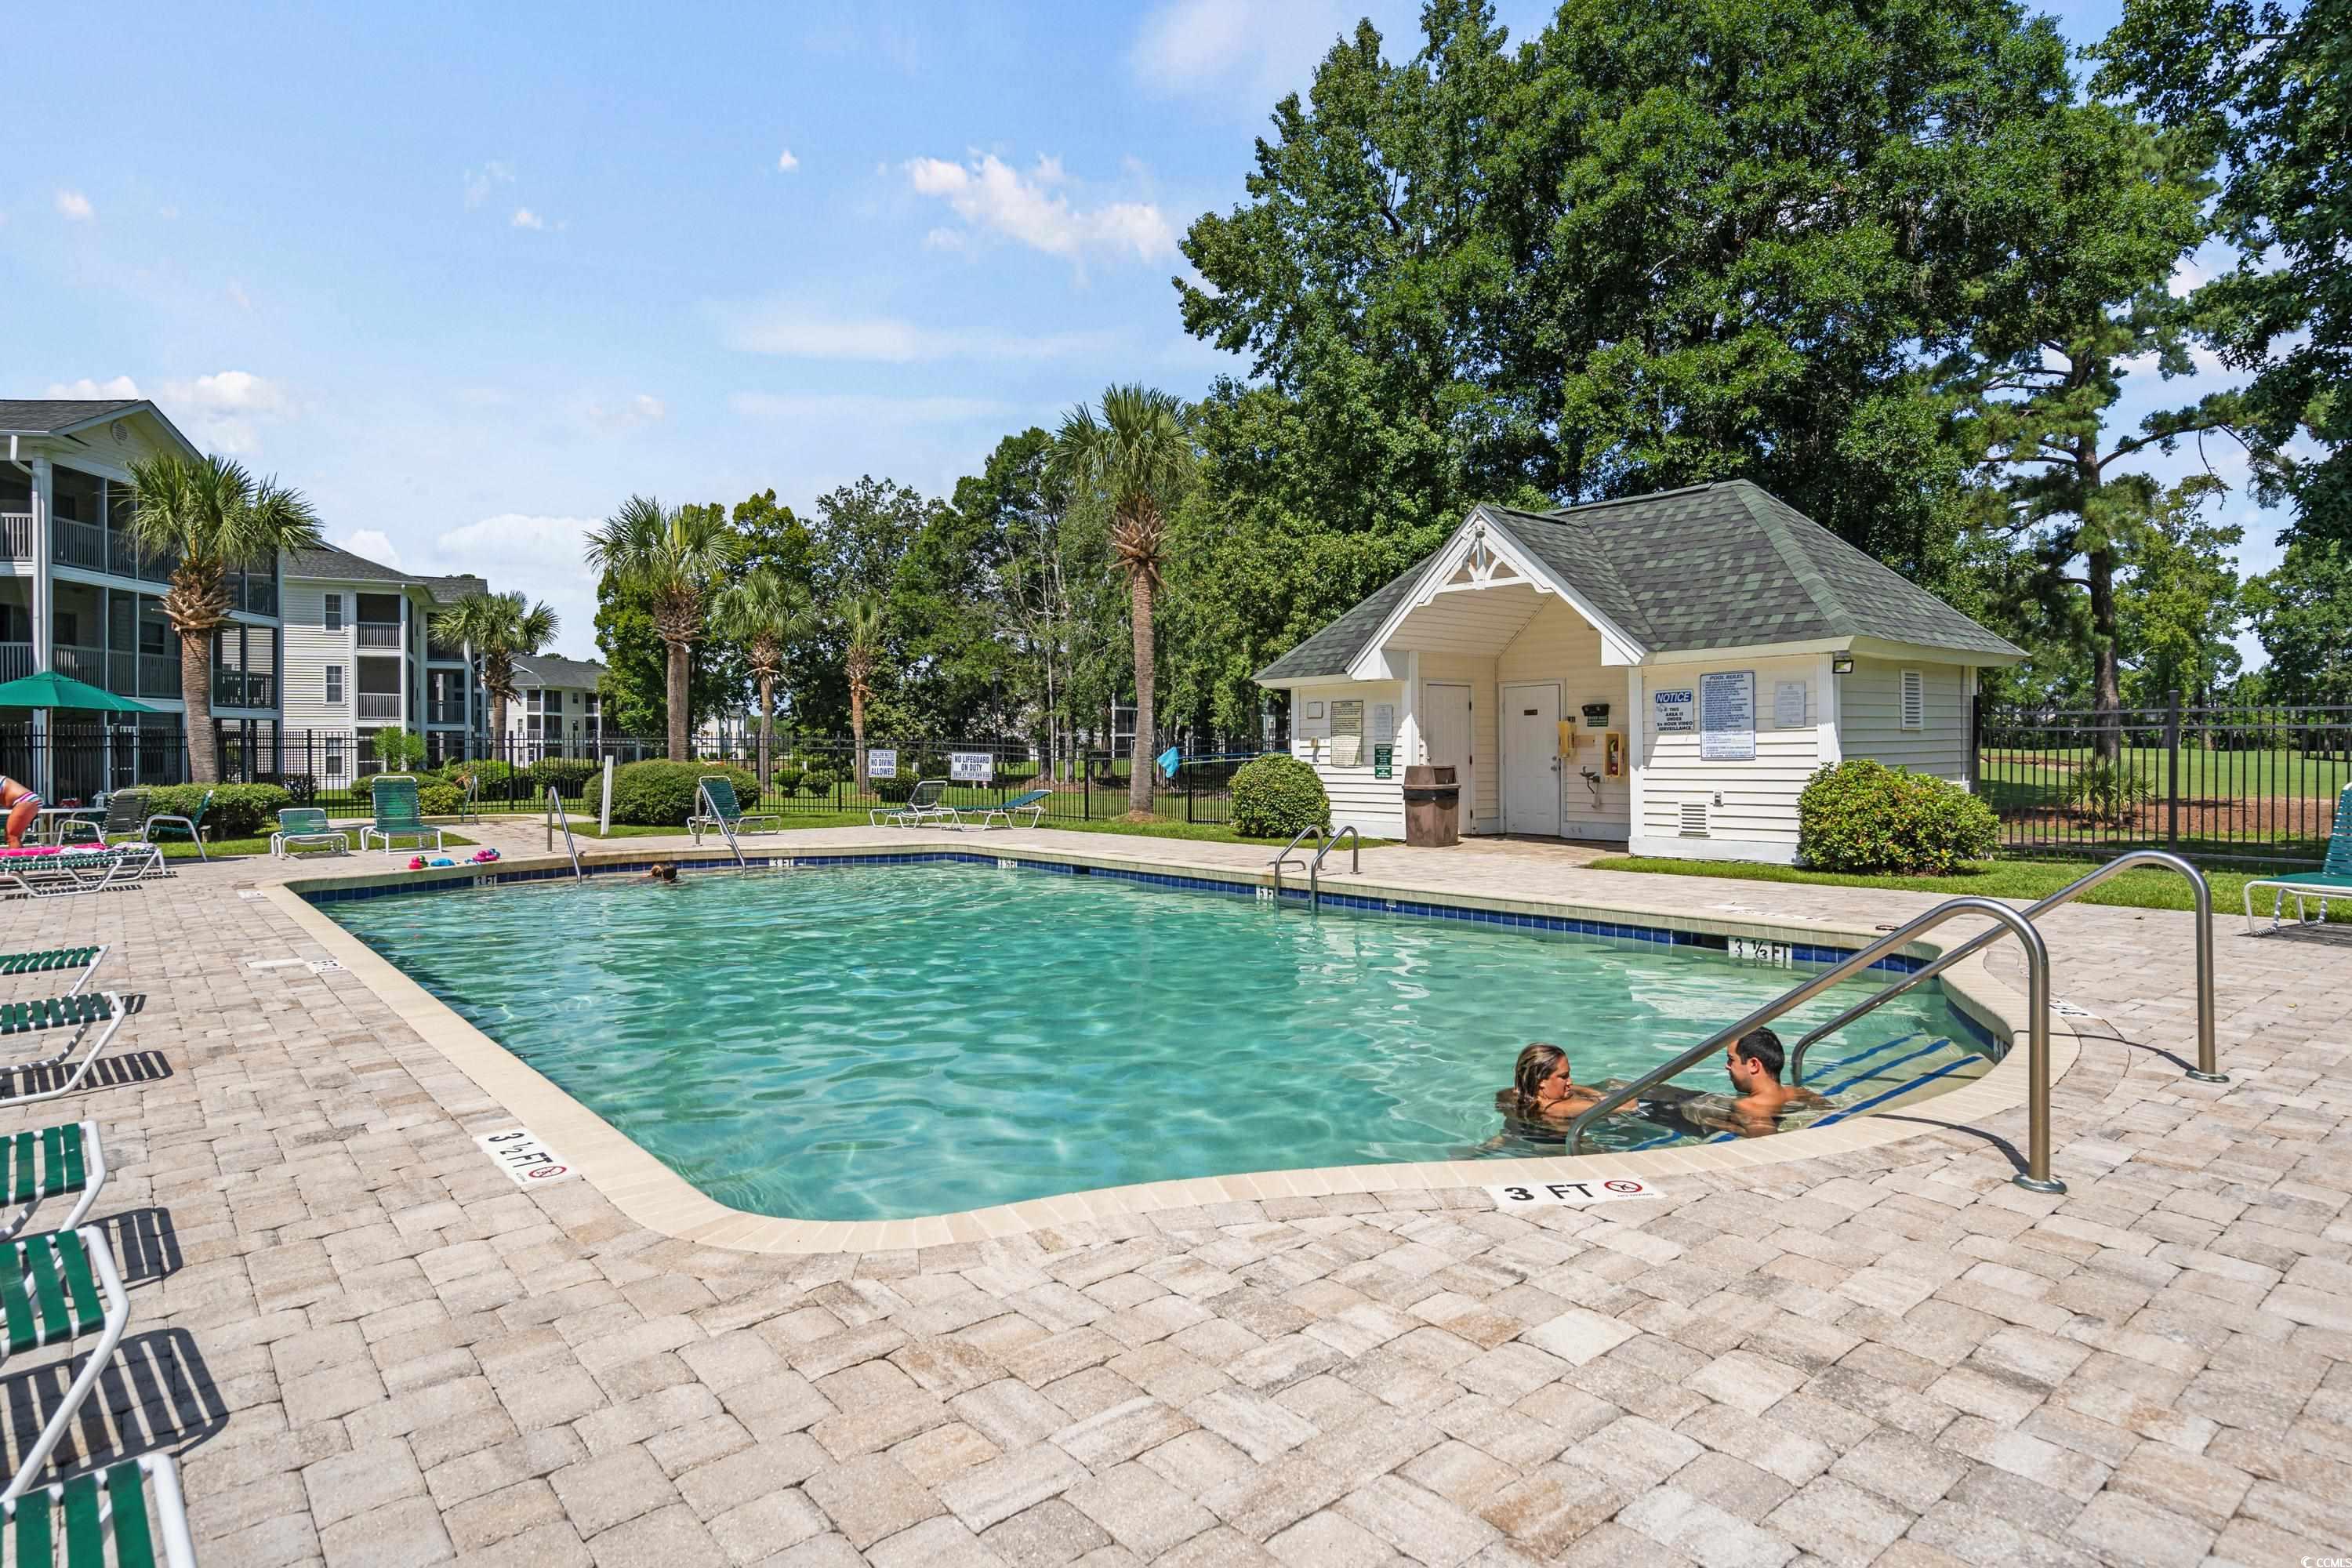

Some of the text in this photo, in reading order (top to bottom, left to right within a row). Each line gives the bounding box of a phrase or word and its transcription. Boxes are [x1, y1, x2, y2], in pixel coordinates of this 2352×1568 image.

[1656, 692, 1690, 703] NOTICE
[871, 758, 894, 767] NO DIVING
[963, 755, 989, 764] LIFEGUARD
[1735, 938, 1742, 956] 3
[1772, 942, 1791, 958] FT
[488, 1132, 525, 1142] 3
[506, 1152, 554, 1168] FT
[1504, 1183, 1594, 1201] 3 FT
